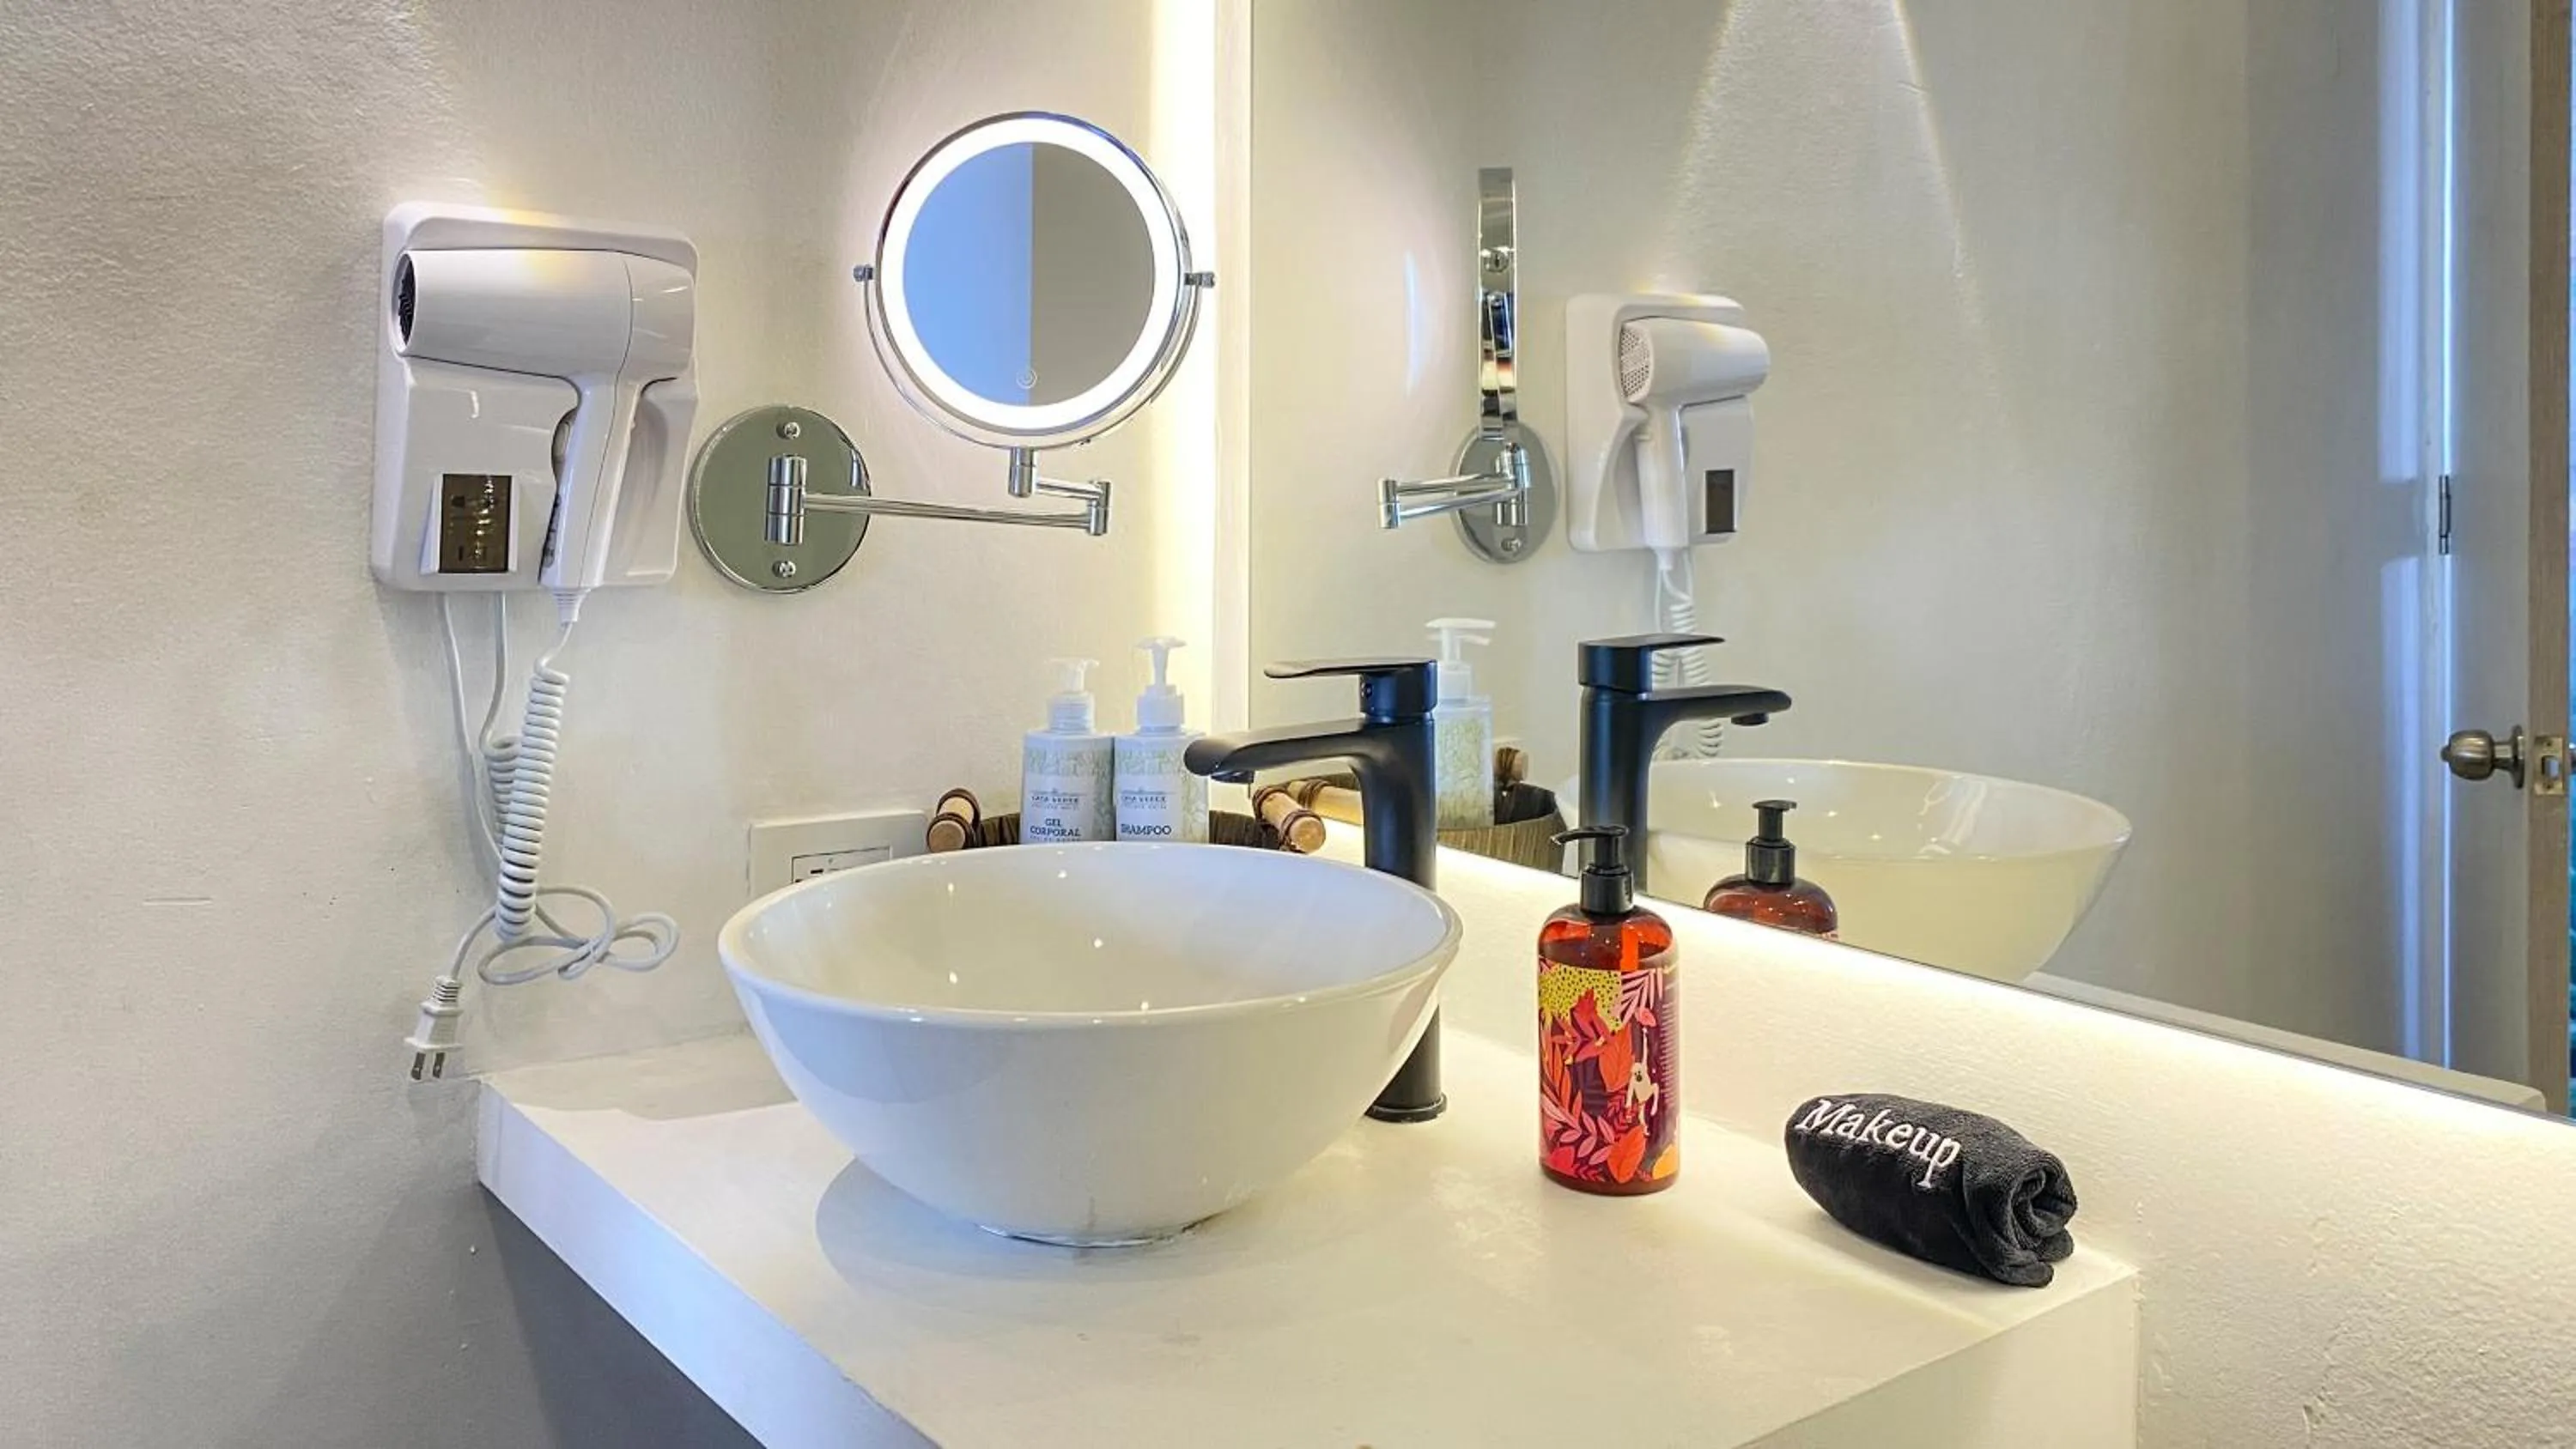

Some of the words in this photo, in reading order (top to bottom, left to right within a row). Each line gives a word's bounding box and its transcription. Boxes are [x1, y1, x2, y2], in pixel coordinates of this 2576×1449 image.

[1045, 818, 1061, 827] GEL
[1030, 825, 1082, 836] CORPORAL
[1121, 823, 1172, 835] SHAMPOO
[1794, 1098, 1961, 1188] Makeup
